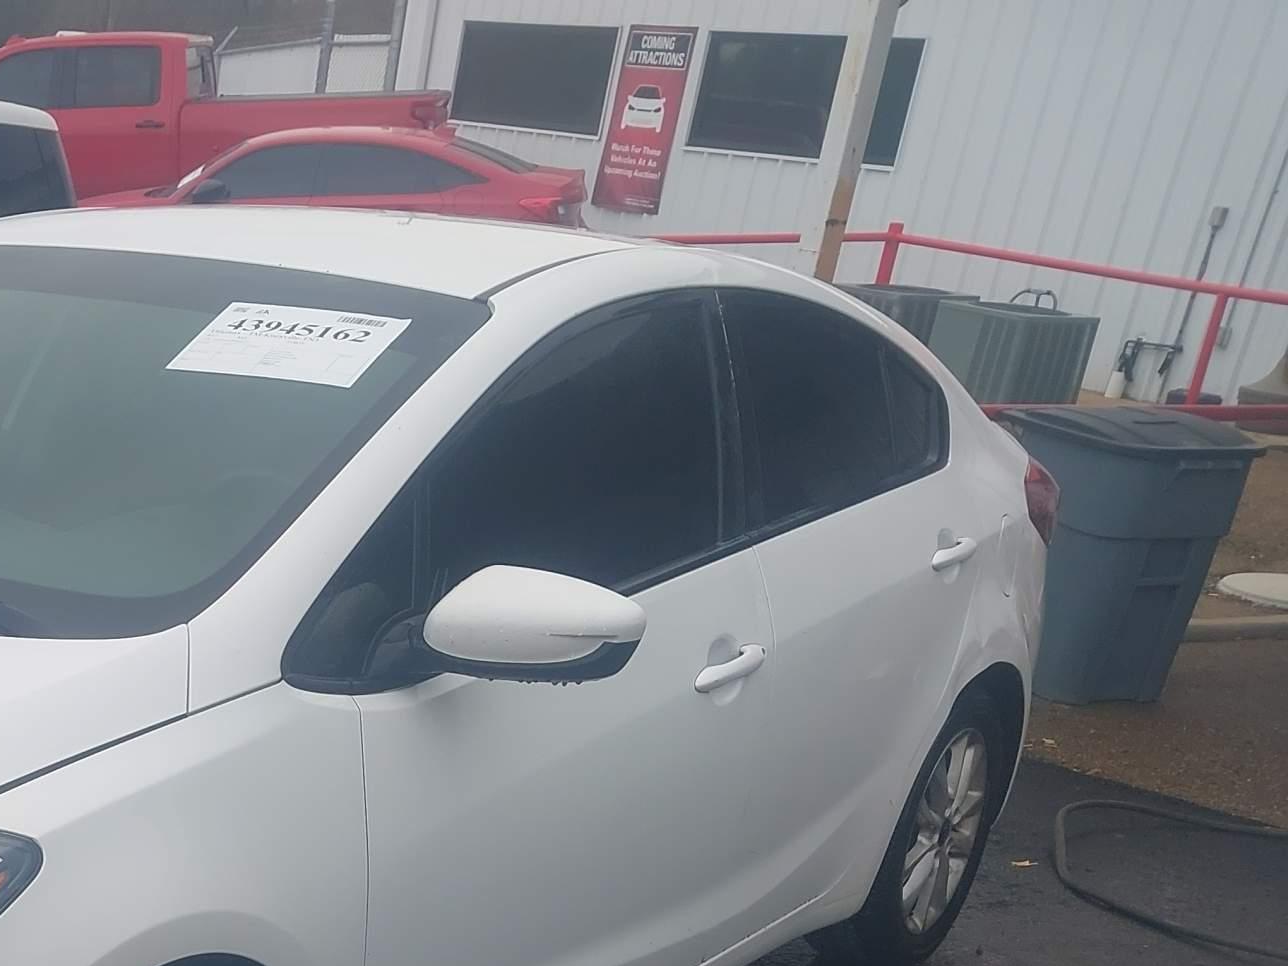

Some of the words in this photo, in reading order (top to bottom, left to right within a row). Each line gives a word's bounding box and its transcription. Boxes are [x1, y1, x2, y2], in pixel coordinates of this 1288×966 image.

[641, 35, 676, 50] COMING
[629, 50, 686, 66] ATTRACTIONS
[227, 319, 371, 343] 43945162
